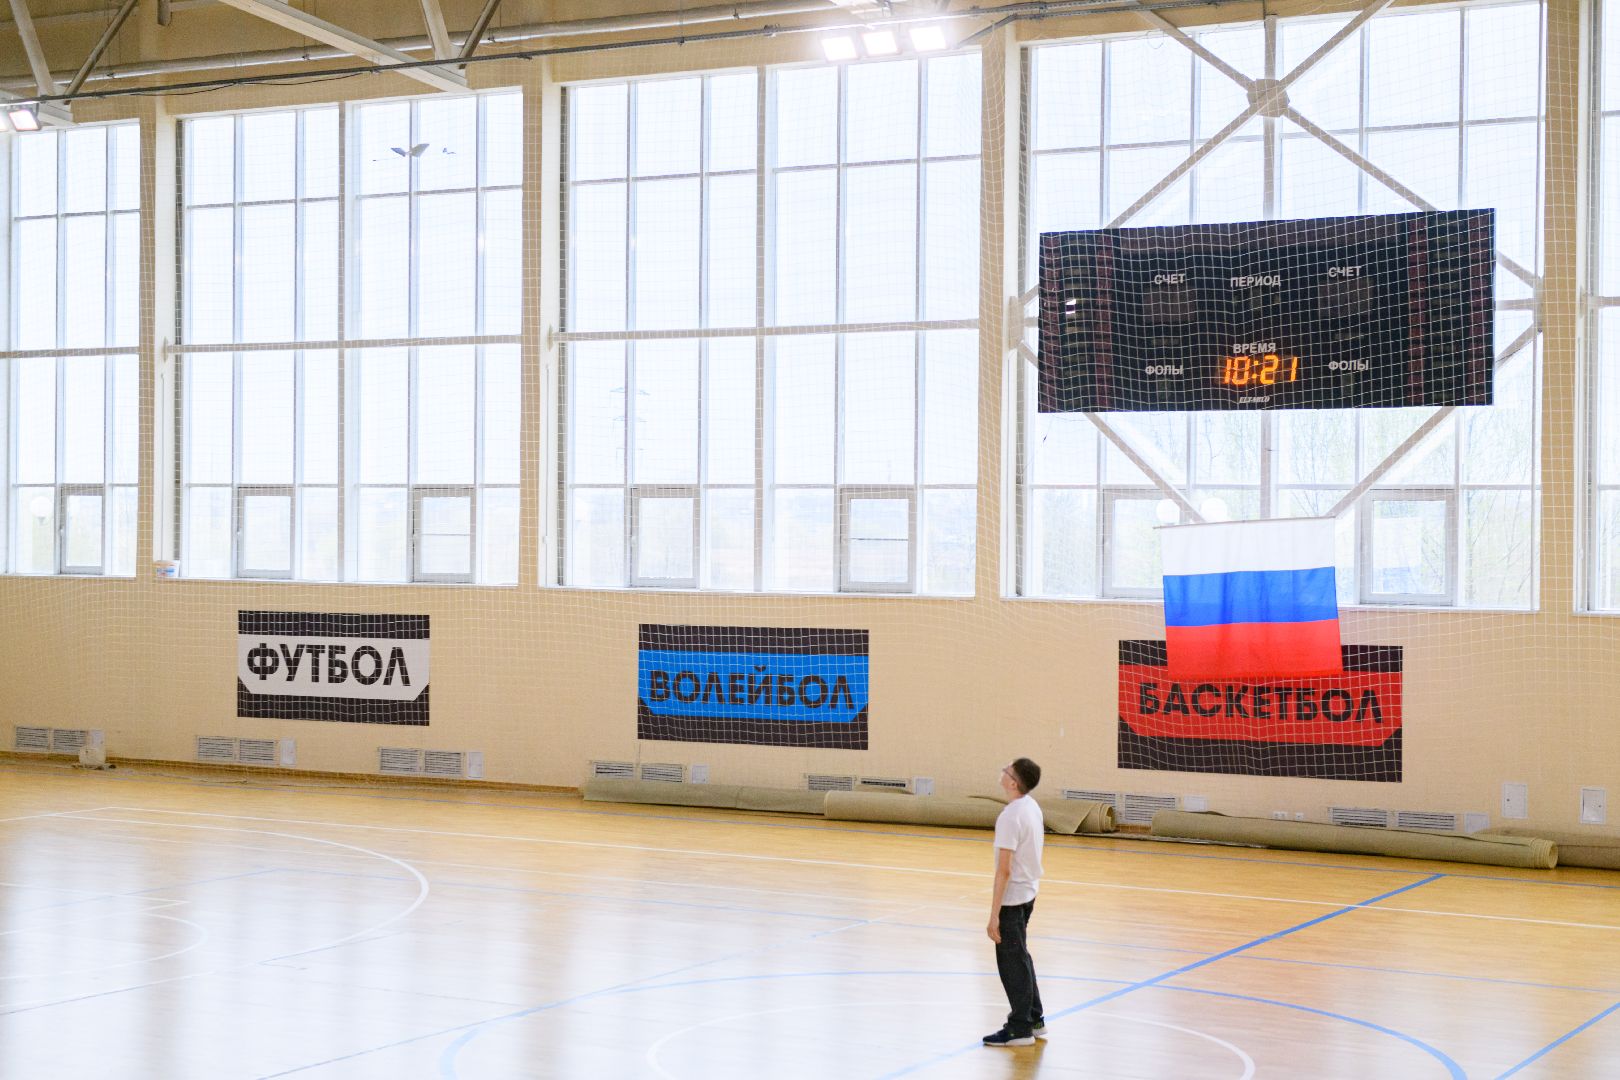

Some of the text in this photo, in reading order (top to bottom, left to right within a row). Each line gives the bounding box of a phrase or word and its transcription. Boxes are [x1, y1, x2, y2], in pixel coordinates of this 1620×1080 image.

[1328, 265, 1361, 278] СЧЕТ
[1154, 274, 1185, 285] СЧЕТ
[1230, 275, 1281, 288] ПЕРИОД
[1233, 342, 1276, 354] ВРЕМЯ
[1145, 364, 1184, 376] ФОЛЫ
[1224, 354, 1298, 385] 10:21
[1328, 359, 1369, 371] ФОЛЫ
[246, 642, 411, 686] ФУТБОЛ
[649, 665, 855, 710] ВОЛЕЙБОЛ
[1139, 682, 1384, 724] БАСКЕТБОЛ
